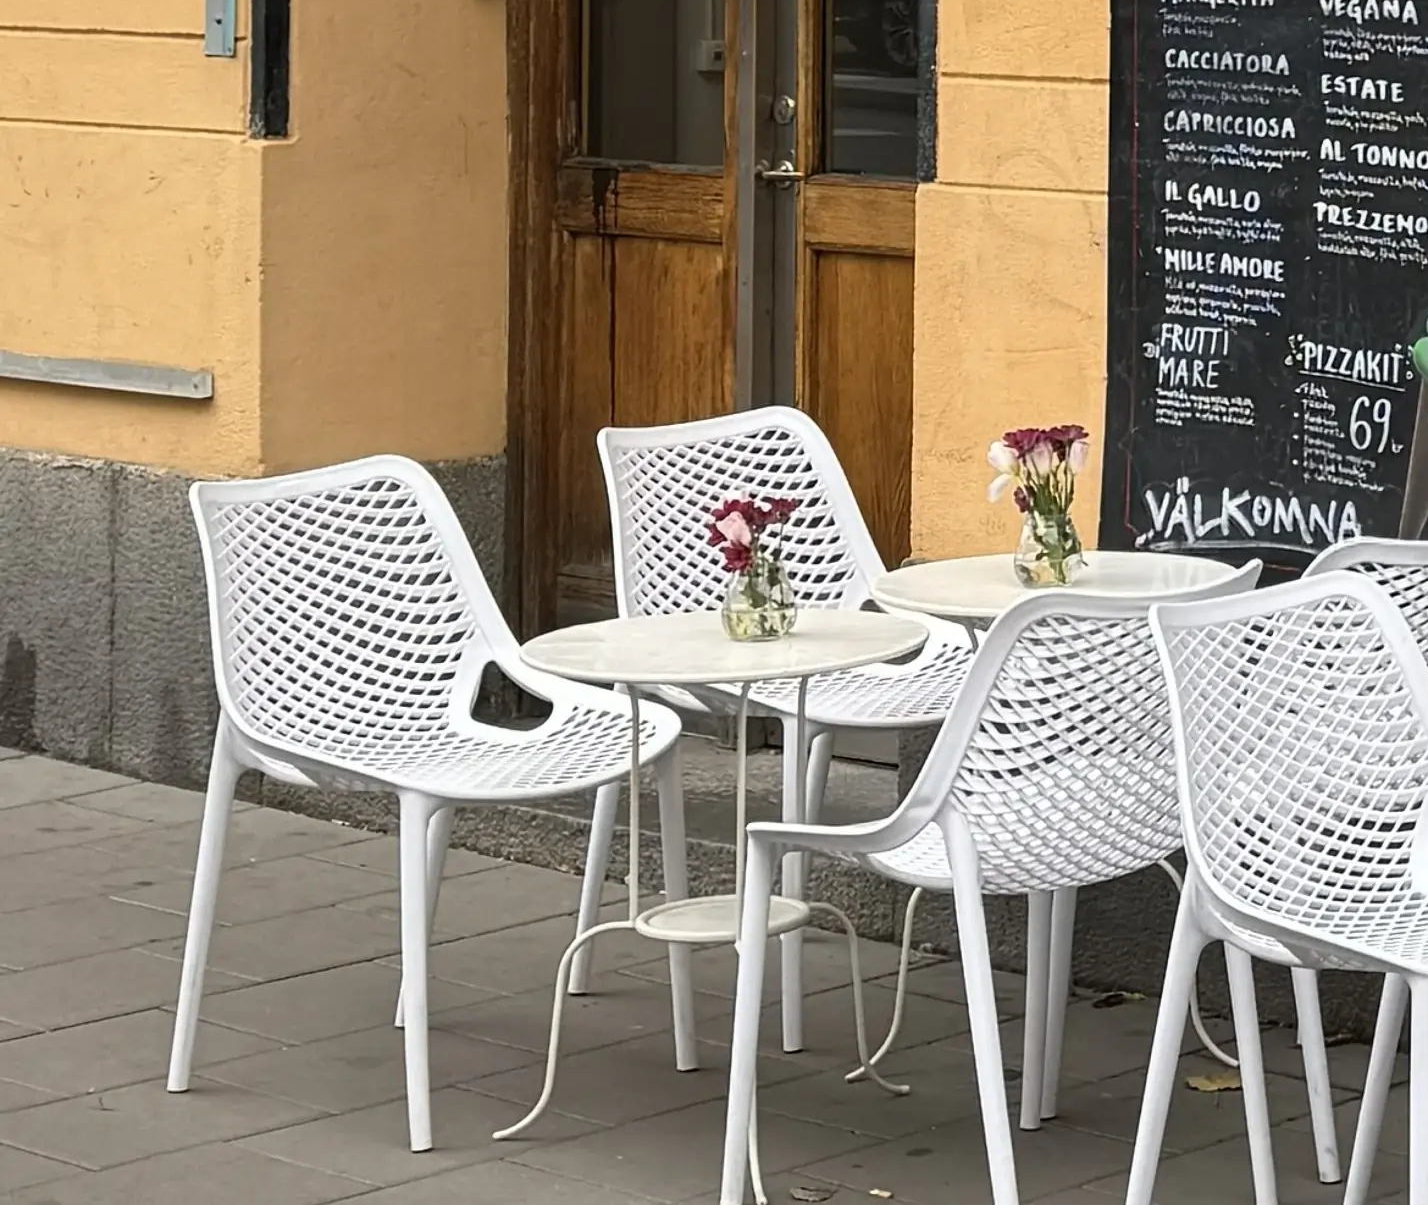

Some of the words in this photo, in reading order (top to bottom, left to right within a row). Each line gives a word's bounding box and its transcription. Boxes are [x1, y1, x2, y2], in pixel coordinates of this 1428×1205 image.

[1164, 48, 1291, 76] CACCIATORA
[1321, 74, 1405, 103] ESTATE
[1163, 109, 1297, 139] CAPRICCIOSA
[1319, 138, 1346, 162] AL
[1165, 180, 1183, 202] IL
[1187, 183, 1262, 212] GALLO
[1164, 247, 1216, 275] MILLE
[1218, 252, 1285, 283] AMORE
[1160, 322, 1230, 357] FRUTTI
[1158, 356, 1222, 389] MARE
[1299, 340, 1405, 385] PIZZAKIT
[1349, 395, 1393, 454] 69
[1144, 478, 1364, 545] VÄLKOMNA
